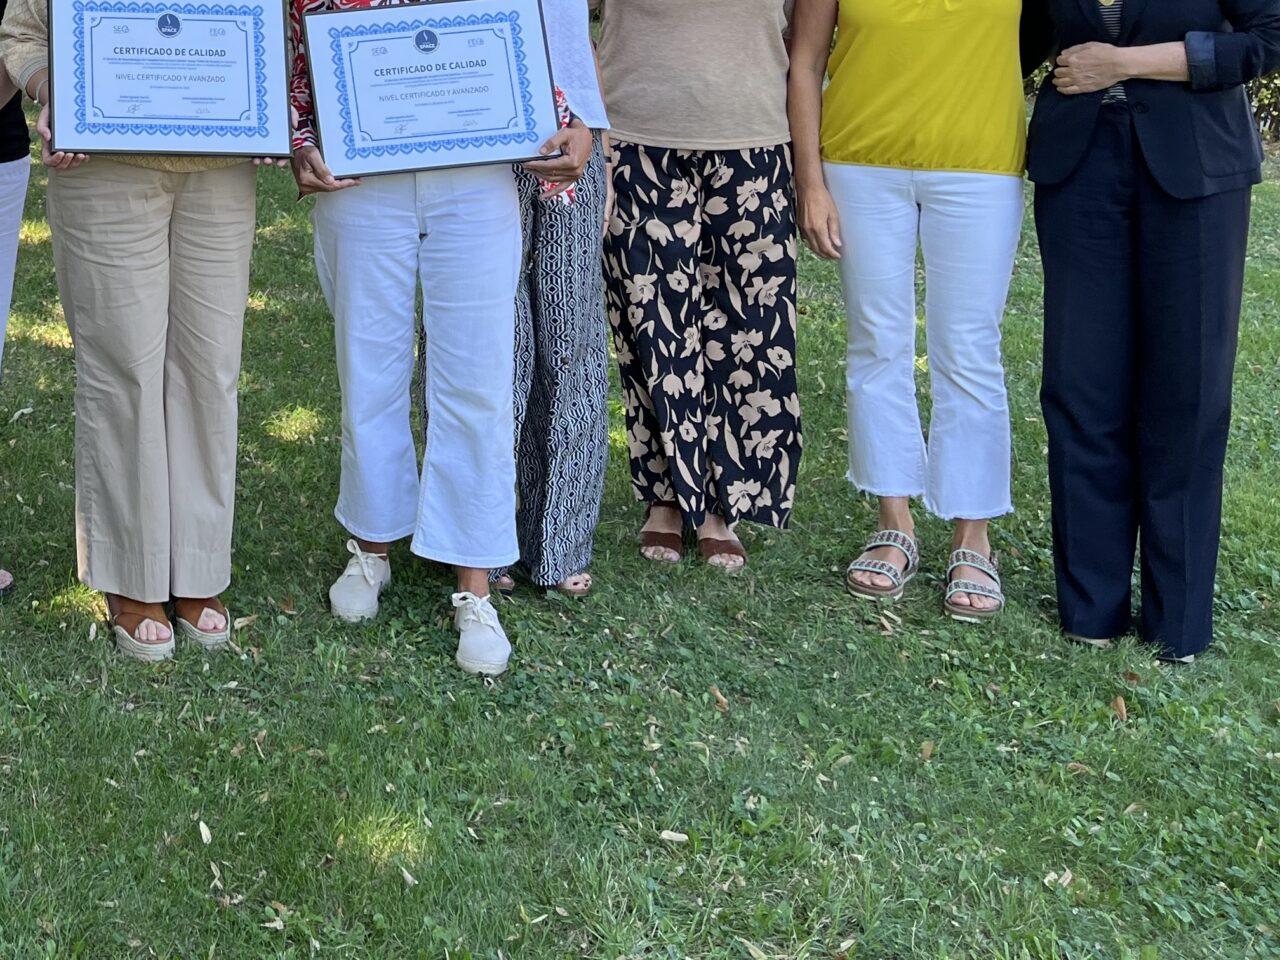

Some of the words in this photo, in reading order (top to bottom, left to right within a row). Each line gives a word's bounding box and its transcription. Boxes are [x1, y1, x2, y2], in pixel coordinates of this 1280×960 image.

[113, 46, 173, 56] CERTIFICADO
[174, 48, 186, 56] DE
[188, 48, 226, 57] CALIDAD
[374, 64, 433, 77] CERTIFICADO
[435, 63, 447, 71] DE
[448, 59, 487, 70] CALIDAD
[115, 73, 135, 81] NIVEL
[136, 73, 182, 82] CERTIFICADO
[188, 75, 226, 83] AVANZADO
[379, 94, 400, 102] NIVEL
[400, 89, 445, 101] CERTIFICADO
[452, 85, 489, 96] AVANZADO
